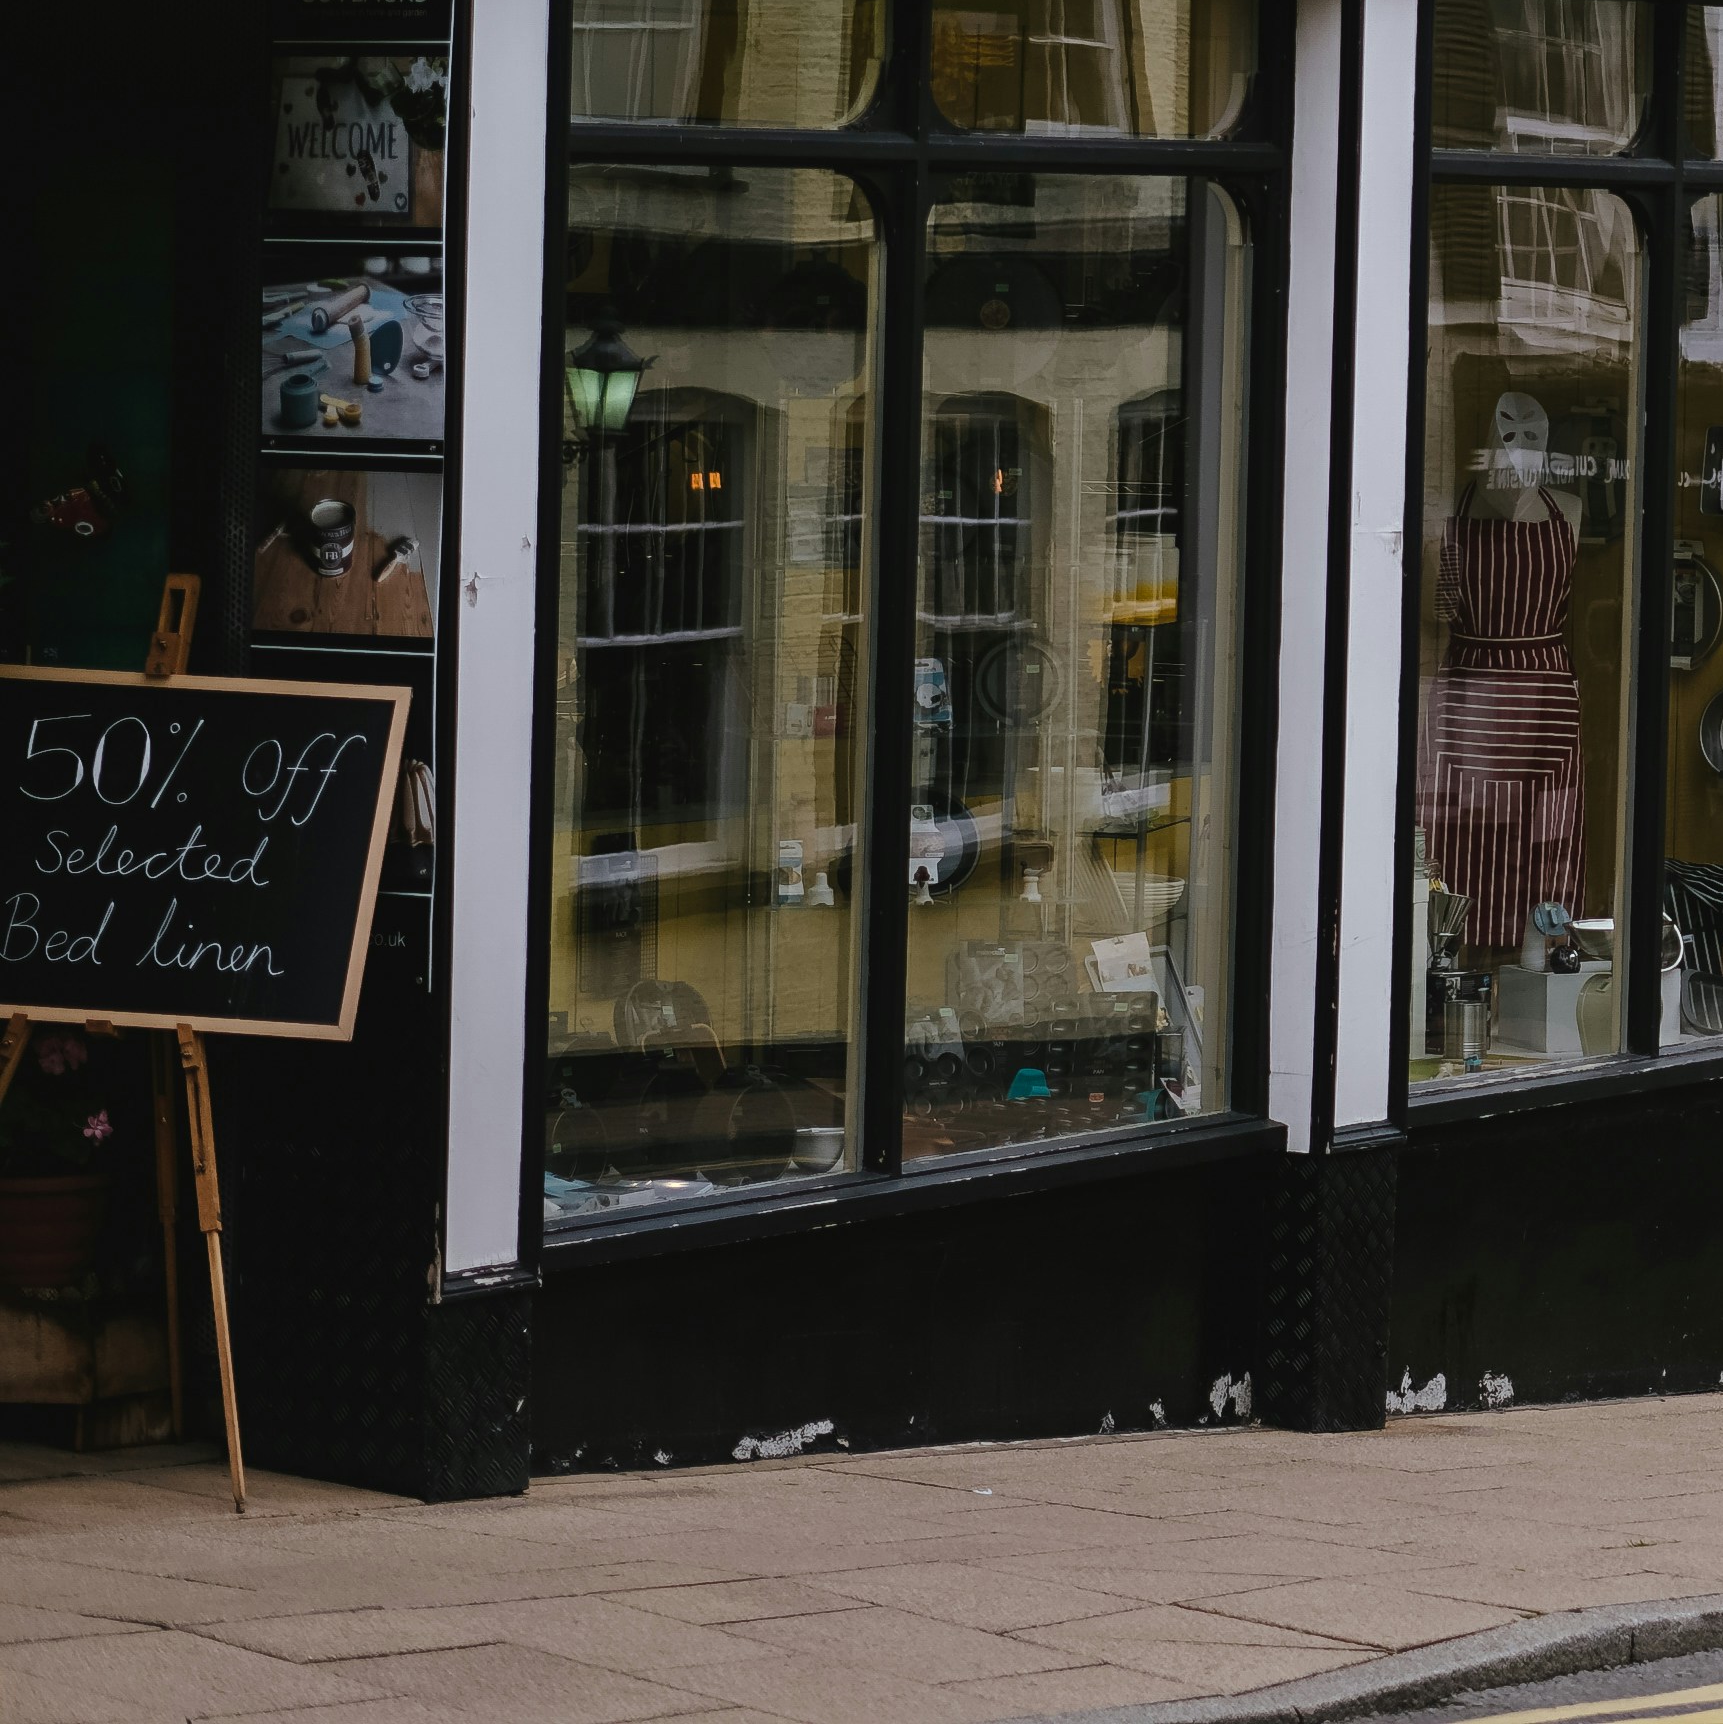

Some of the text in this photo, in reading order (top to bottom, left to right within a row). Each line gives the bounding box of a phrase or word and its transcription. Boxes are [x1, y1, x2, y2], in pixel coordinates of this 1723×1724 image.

[287, 122, 399, 160] WELCOME
[18, 713, 205, 808] 50%
[0, 891, 285, 977] Bed linen
